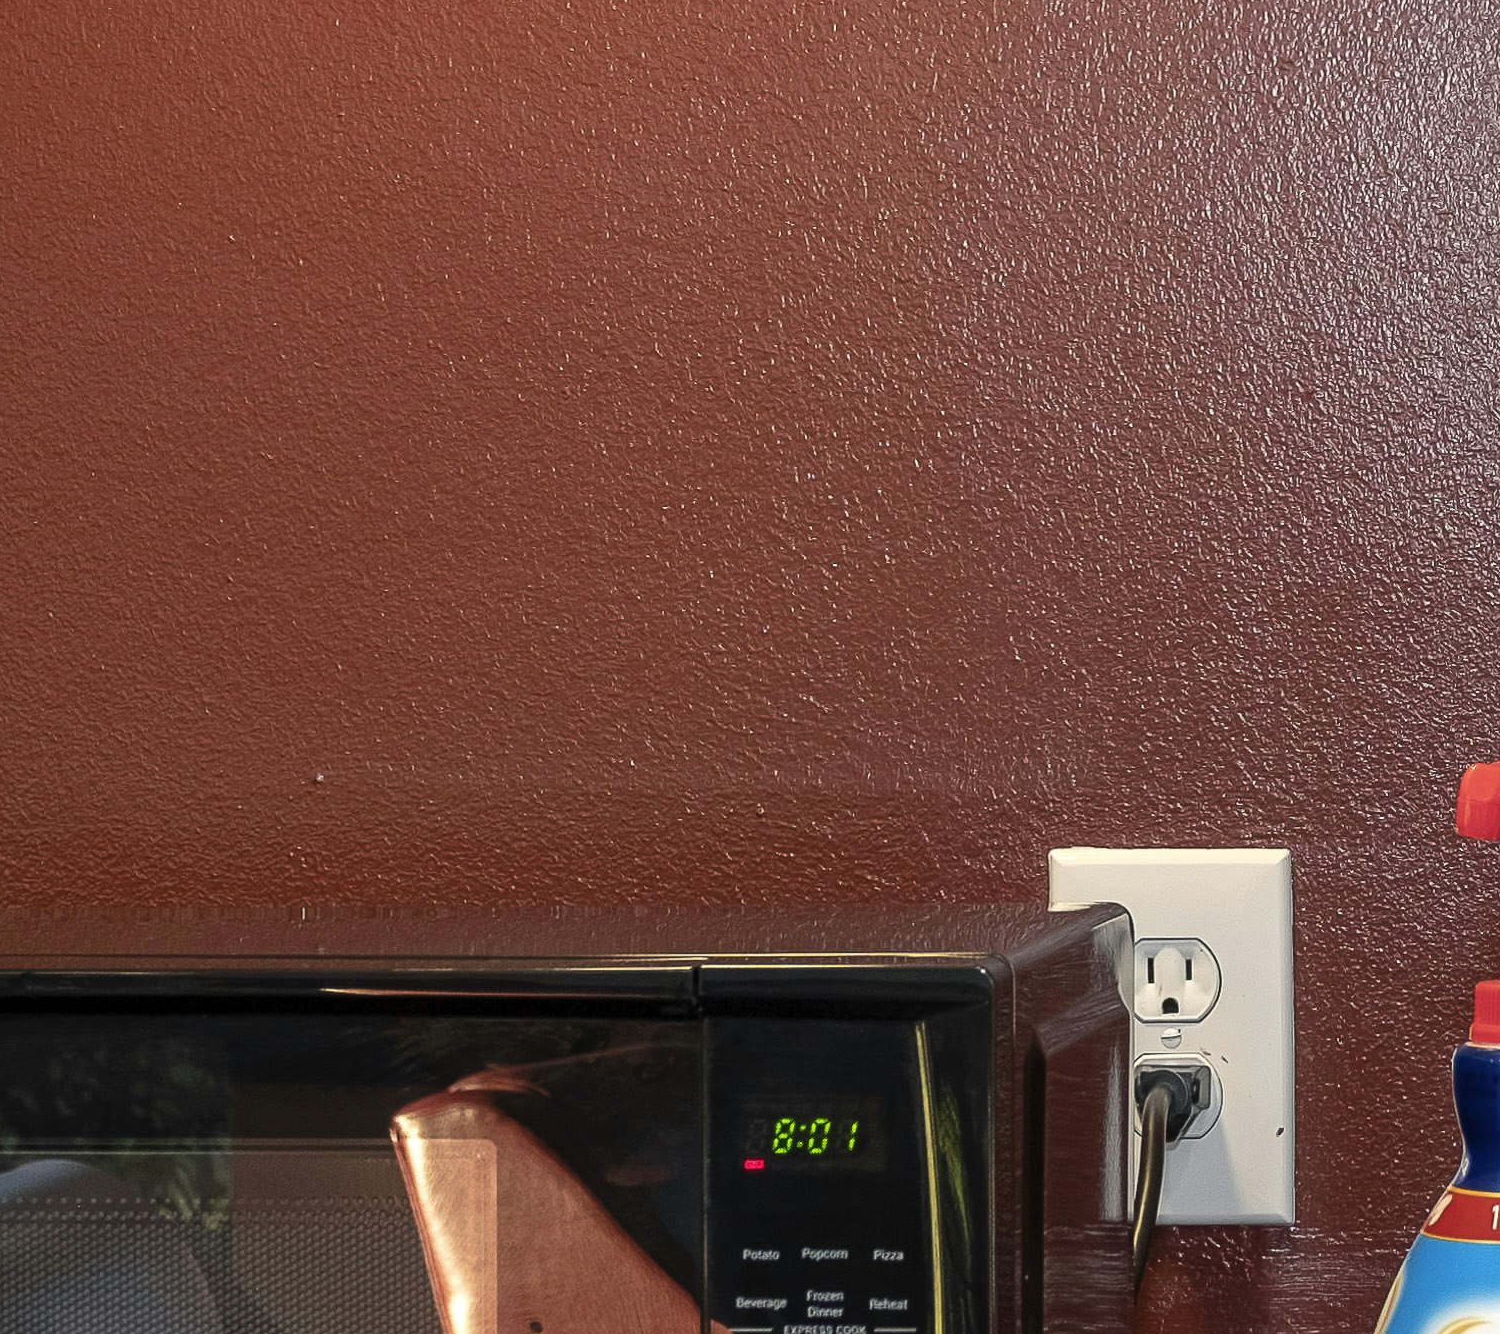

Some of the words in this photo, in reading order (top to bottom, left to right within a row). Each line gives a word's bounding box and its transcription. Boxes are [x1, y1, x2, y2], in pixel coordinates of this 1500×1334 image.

[772, 1118, 859, 1154] 8:01
[1492, 1204, 1500, 1230] 1
[743, 1249, 780, 1260] Potato
[801, 1248, 849, 1262] Popcorn
[873, 1250, 904, 1261] Pizza
[806, 1290, 844, 1301] Frozen
[735, 1296, 787, 1310] Beverage
[869, 1298, 908, 1310] Reheat
[807, 1306, 844, 1318] Dinner
